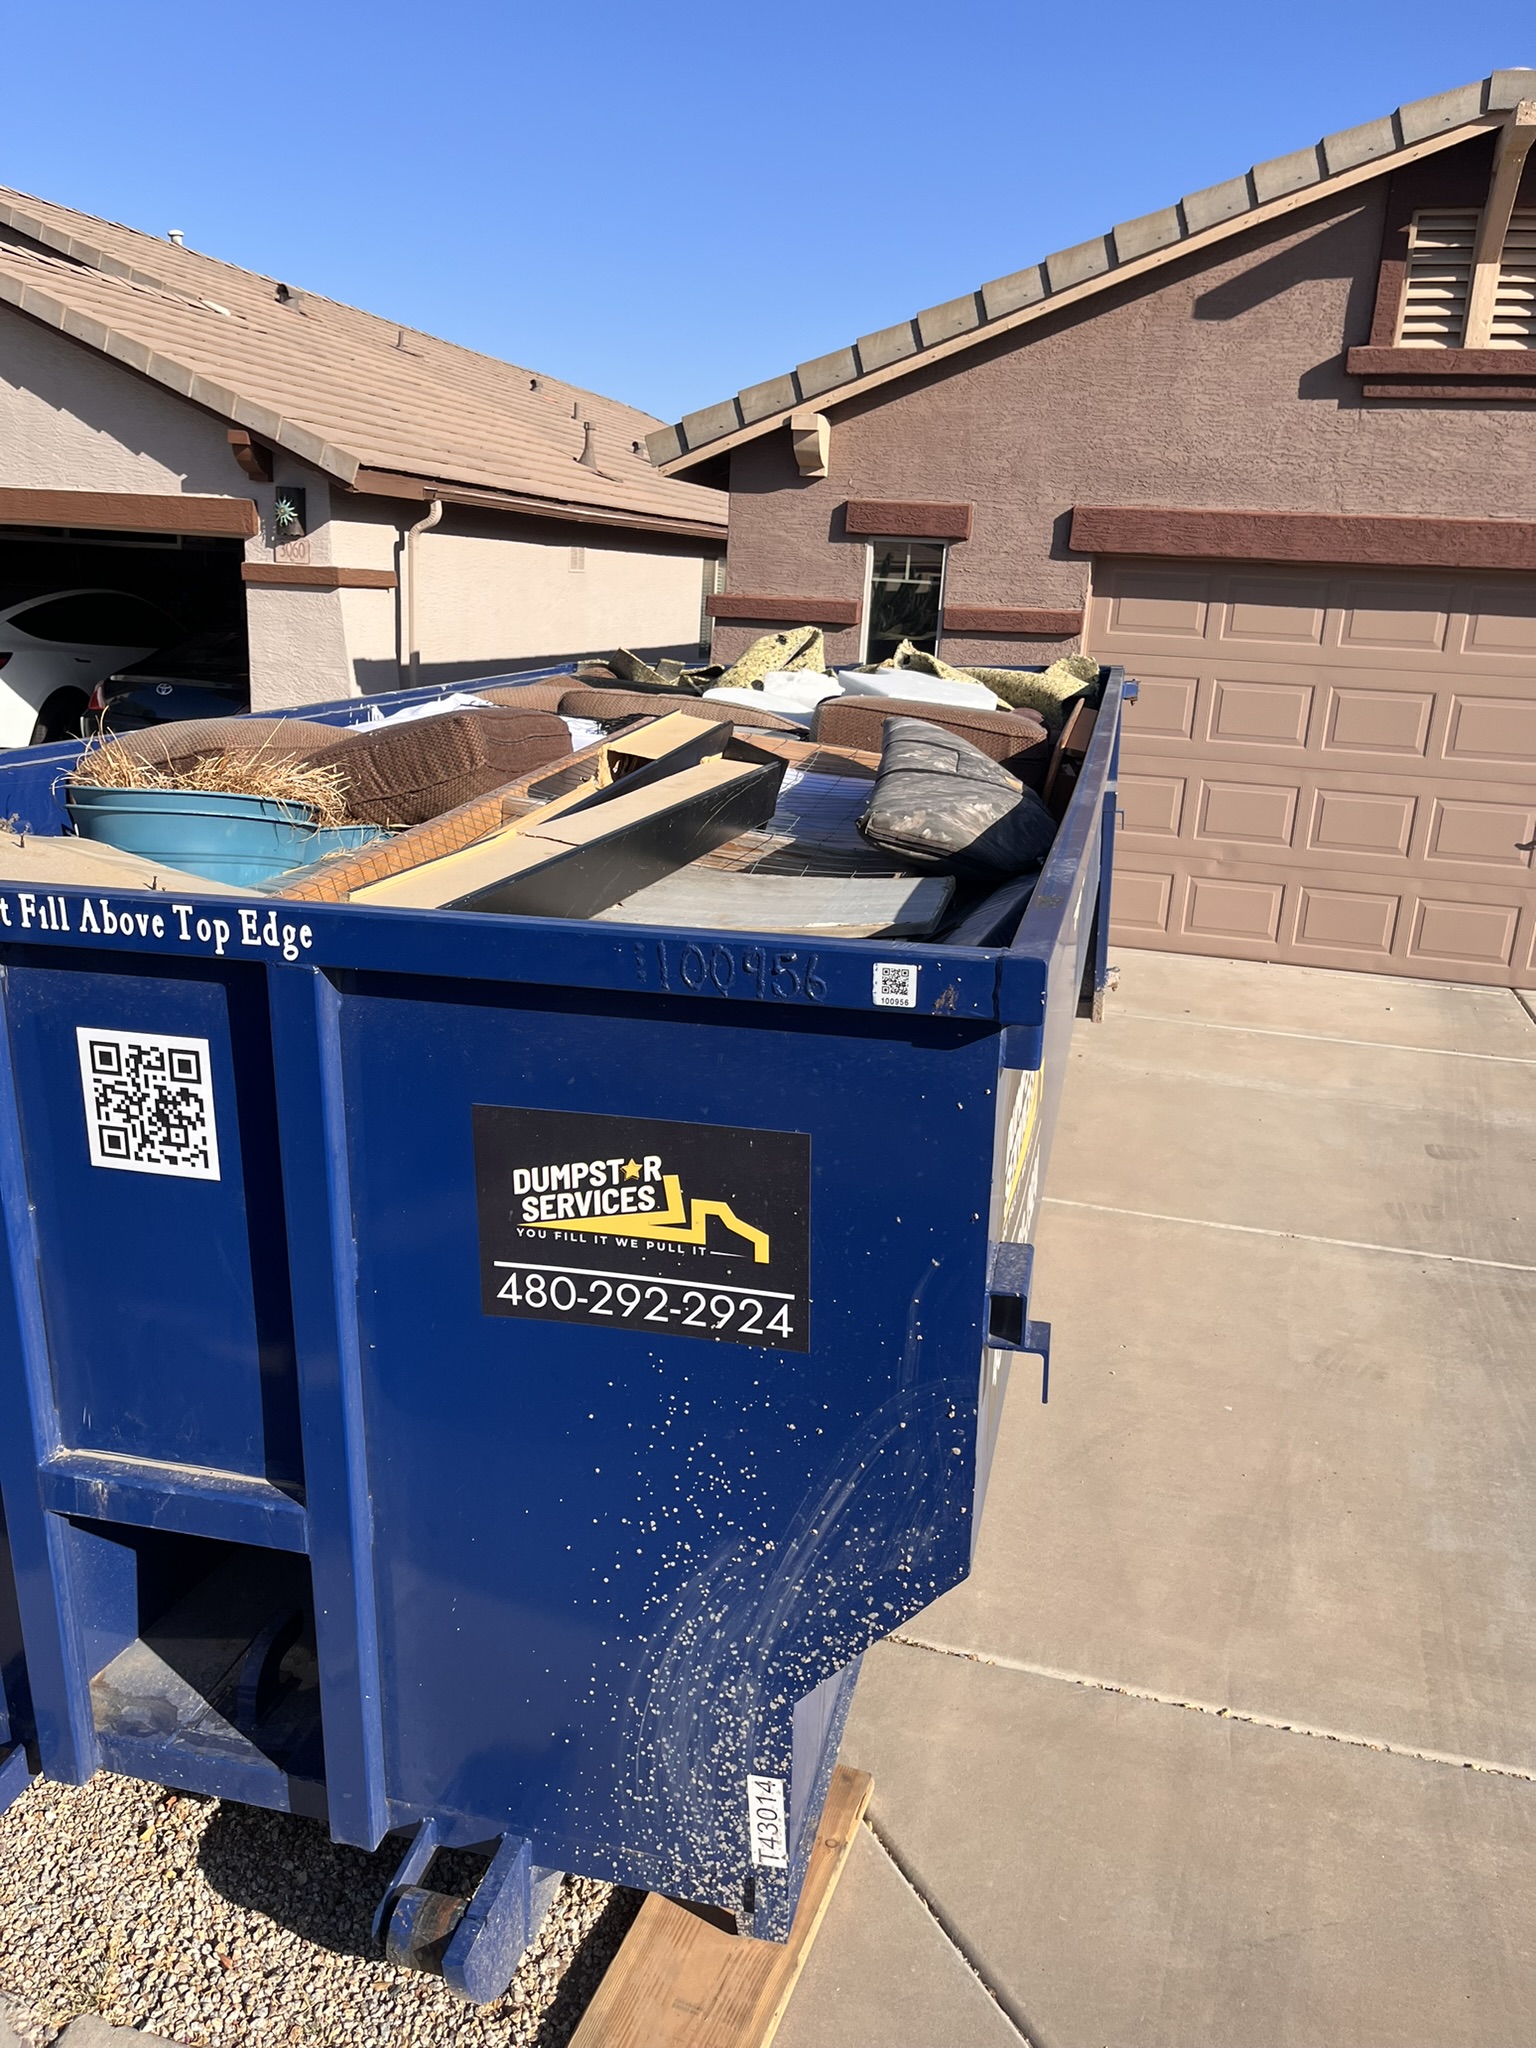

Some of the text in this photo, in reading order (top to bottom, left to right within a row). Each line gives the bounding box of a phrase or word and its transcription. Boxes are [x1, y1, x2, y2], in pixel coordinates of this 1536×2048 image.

[18, 893, 70, 931] Fill
[79, 898, 164, 938] Above
[172, 904, 230, 955] Top
[238, 909, 313, 961] Edge
[881, 997, 909, 1006] 100956
[521, 1185, 656, 1223] SERVICES
[516, 1227, 706, 1257] YOU FILL IT WE PULL IT
[496, 1272, 794, 1338] 480-292-2924
[755, 1780, 779, 1863] T43014
